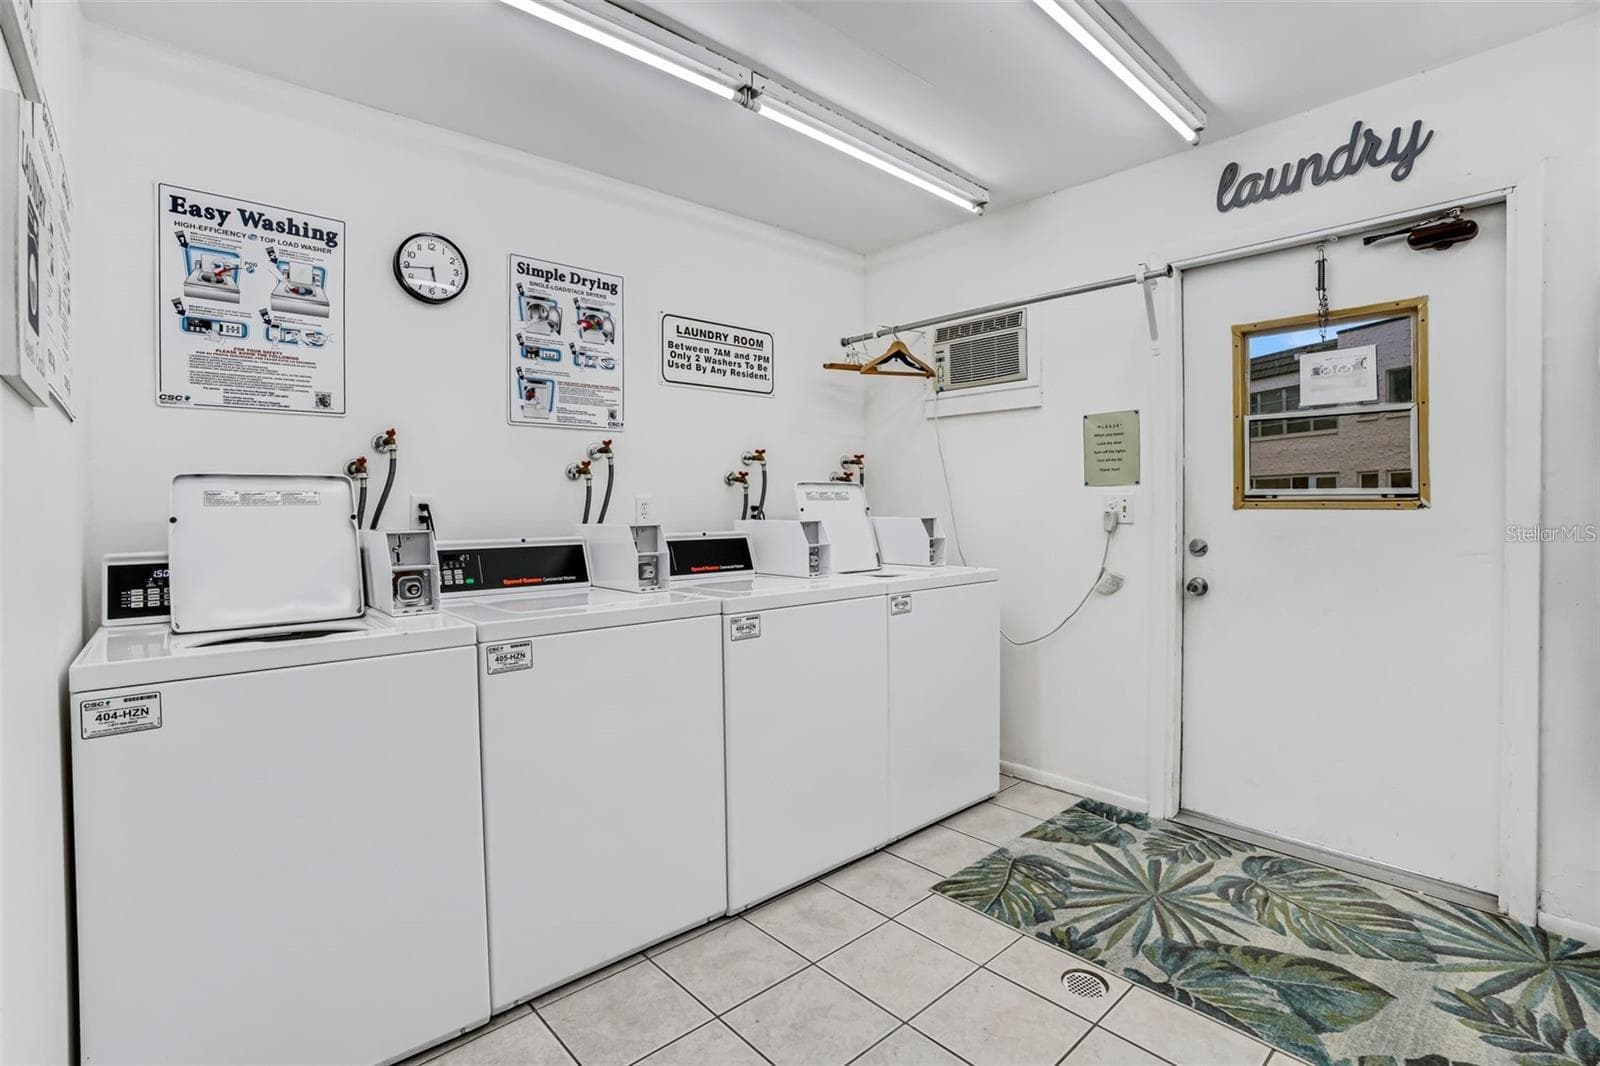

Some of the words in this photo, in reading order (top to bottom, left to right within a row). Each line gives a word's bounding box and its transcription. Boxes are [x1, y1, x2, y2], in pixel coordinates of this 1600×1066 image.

[1217, 119, 1434, 213] laundry
[168, 194, 231, 227] Easy
[237, 207, 339, 249] Washing
[174, 219, 247, 239] HIGH-EFFICIENCY
[260, 236, 276, 244] TOP
[277, 239, 299, 249] LOAD
[301, 242, 332, 255] WASHER
[427, 242, 436, 251] 12
[407, 250, 416, 259] 10
[403, 260, 410, 268] 9
[449, 257, 456, 265] 2
[453, 269, 459, 277] 3
[516, 261, 566, 283] Simple
[569, 272, 618, 296] Drying
[429, 287, 435, 295] 6
[585, 292, 607, 300] DRYERS
[676, 324, 729, 342] LAUNDRY
[733, 335, 764, 348] ROOM
[667, 340, 710, 354] Between
[713, 347, 731, 358] 7AM
[734, 352, 750, 361] and
[752, 354, 770, 364] 7PM
[669, 350, 692, 362] Only
[695, 354, 701, 362] 2
[704, 355, 742, 368] Washers
[744, 361, 755, 370] To
[757, 363, 768, 372] Be
[667, 359, 692, 370] Used
[695, 363, 707, 374] By
[710, 366, 727, 377] Any
[730, 368, 770, 381] Resident.
[159, 394, 184, 402] CSC
[495, 651, 526, 662] 405-HZN
[83, 701, 104, 709] CSC
[95, 707, 150, 722] 404-HZN
